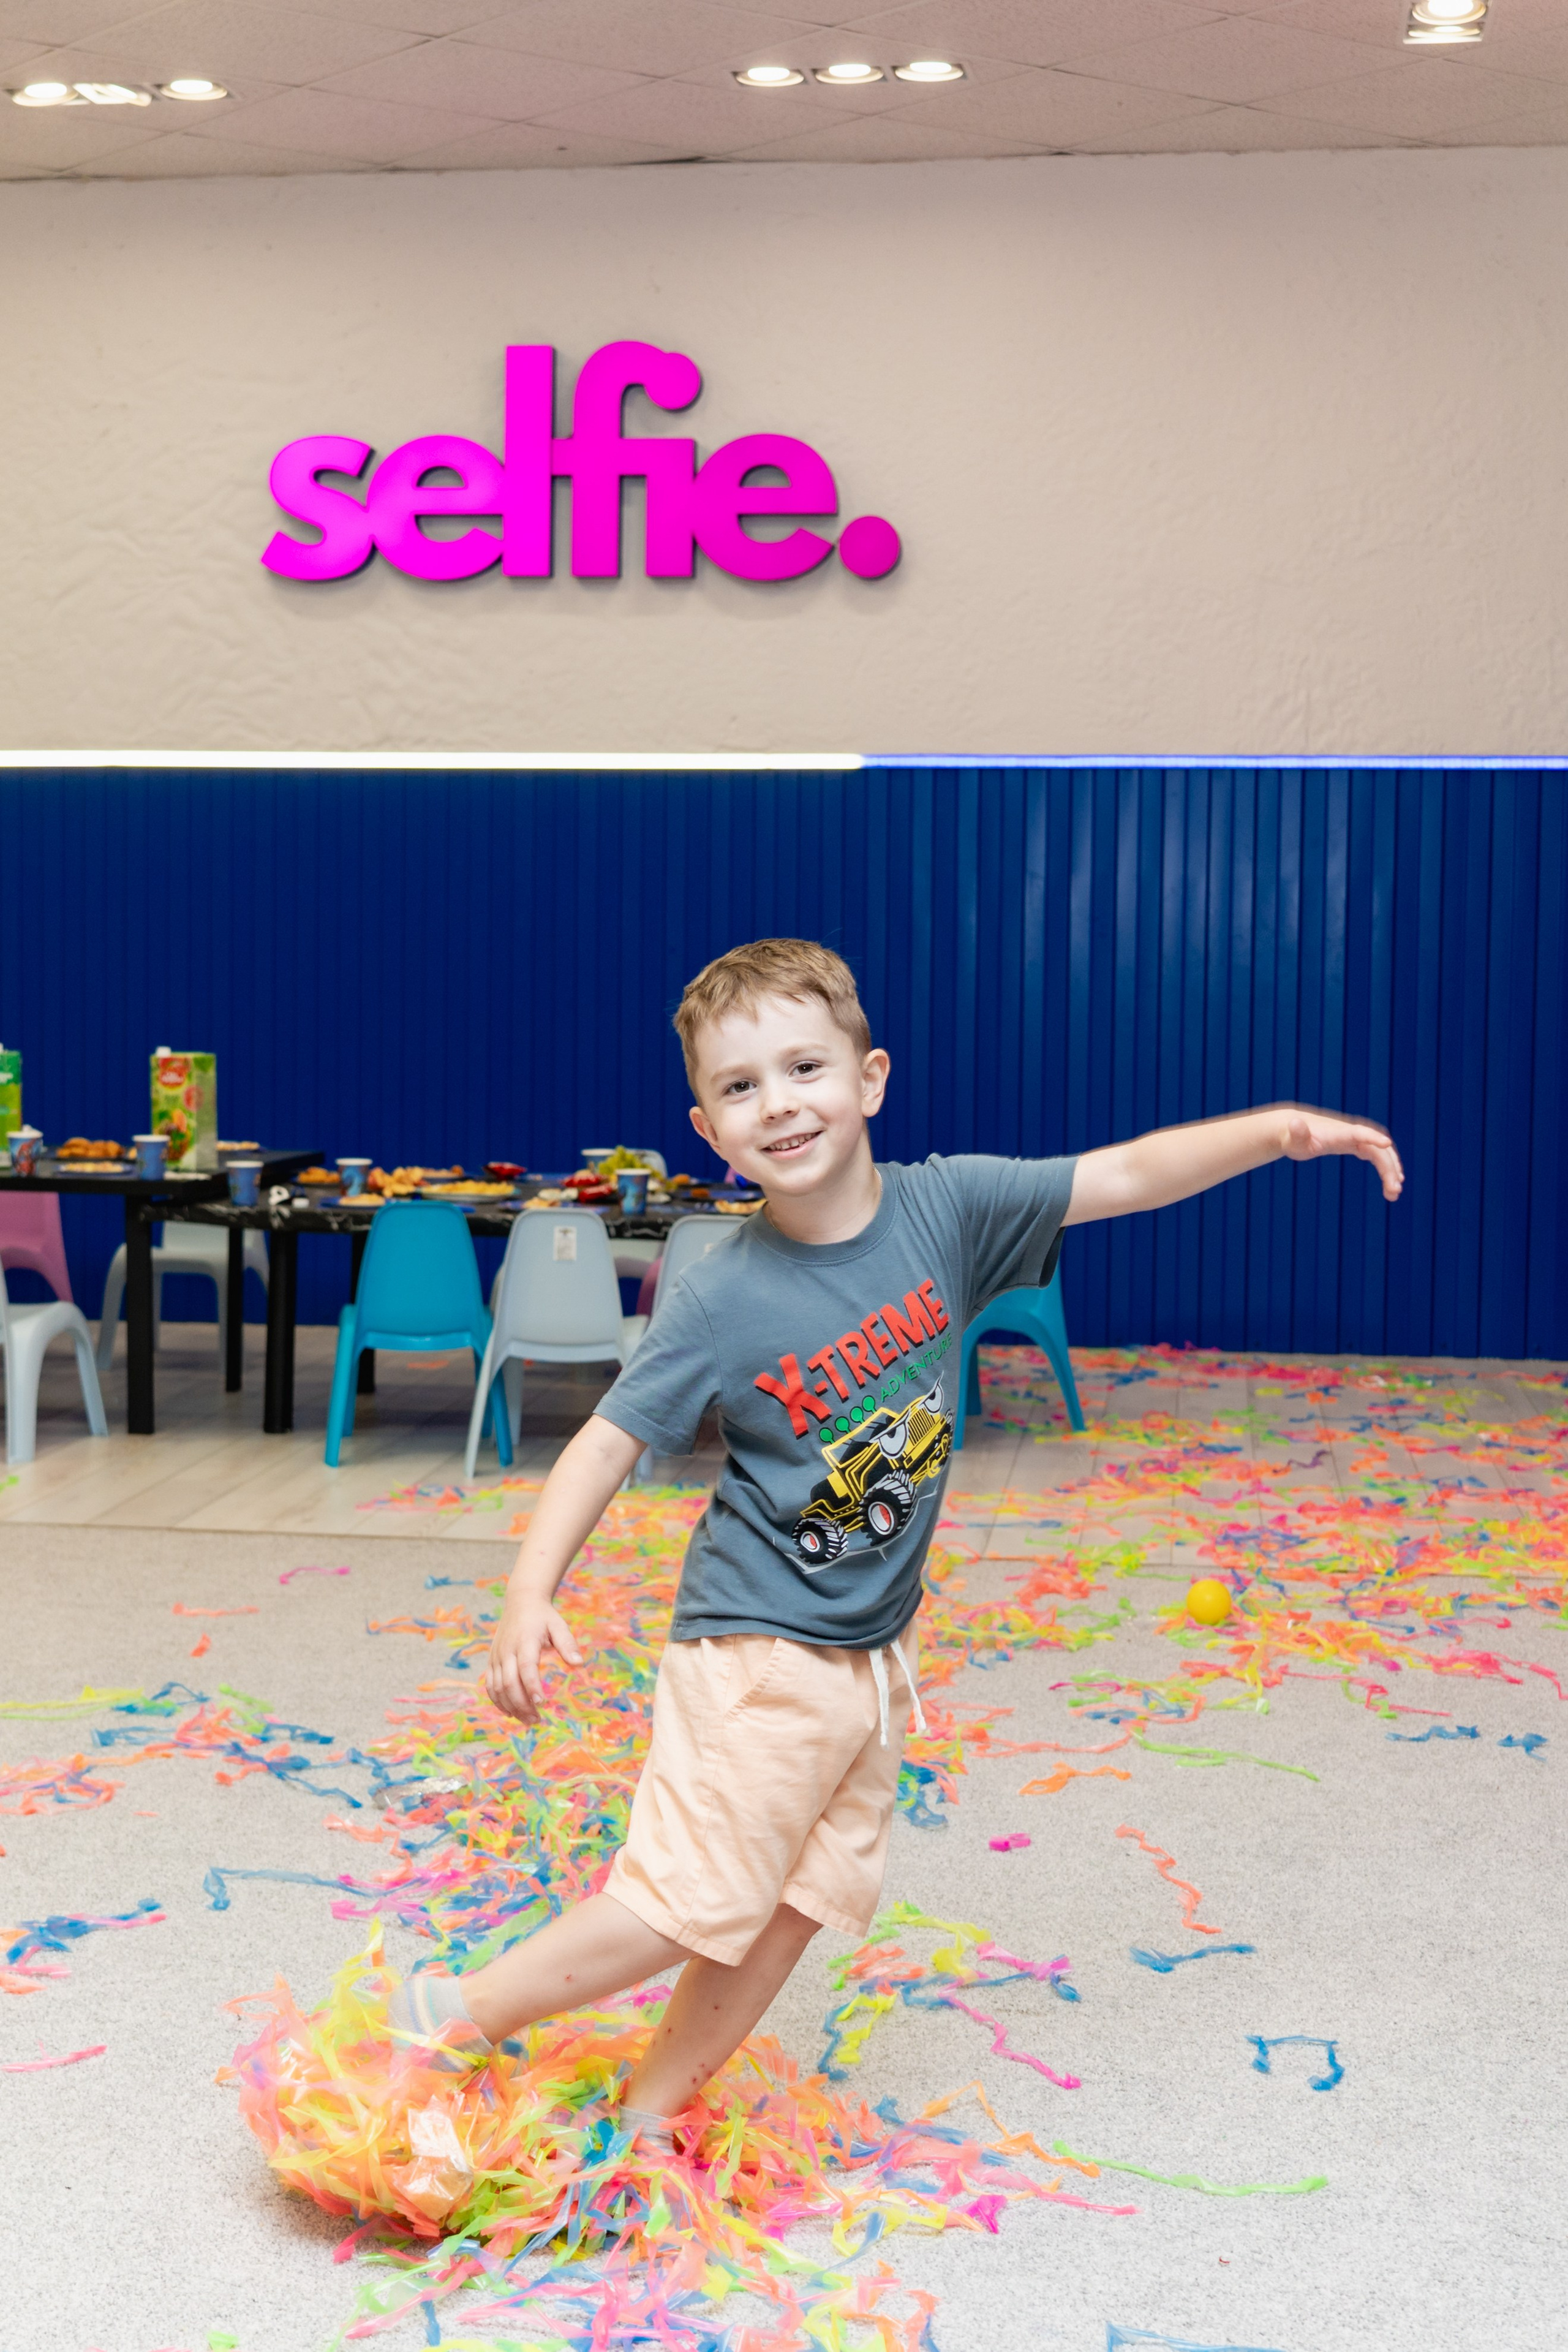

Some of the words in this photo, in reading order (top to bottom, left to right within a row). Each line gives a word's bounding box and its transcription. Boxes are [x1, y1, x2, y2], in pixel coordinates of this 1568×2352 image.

[260, 341, 901, 582] selfie.
[754, 1279, 949, 1438] X-TREME
[880, 1332, 951, 1402] ADVENTURE
